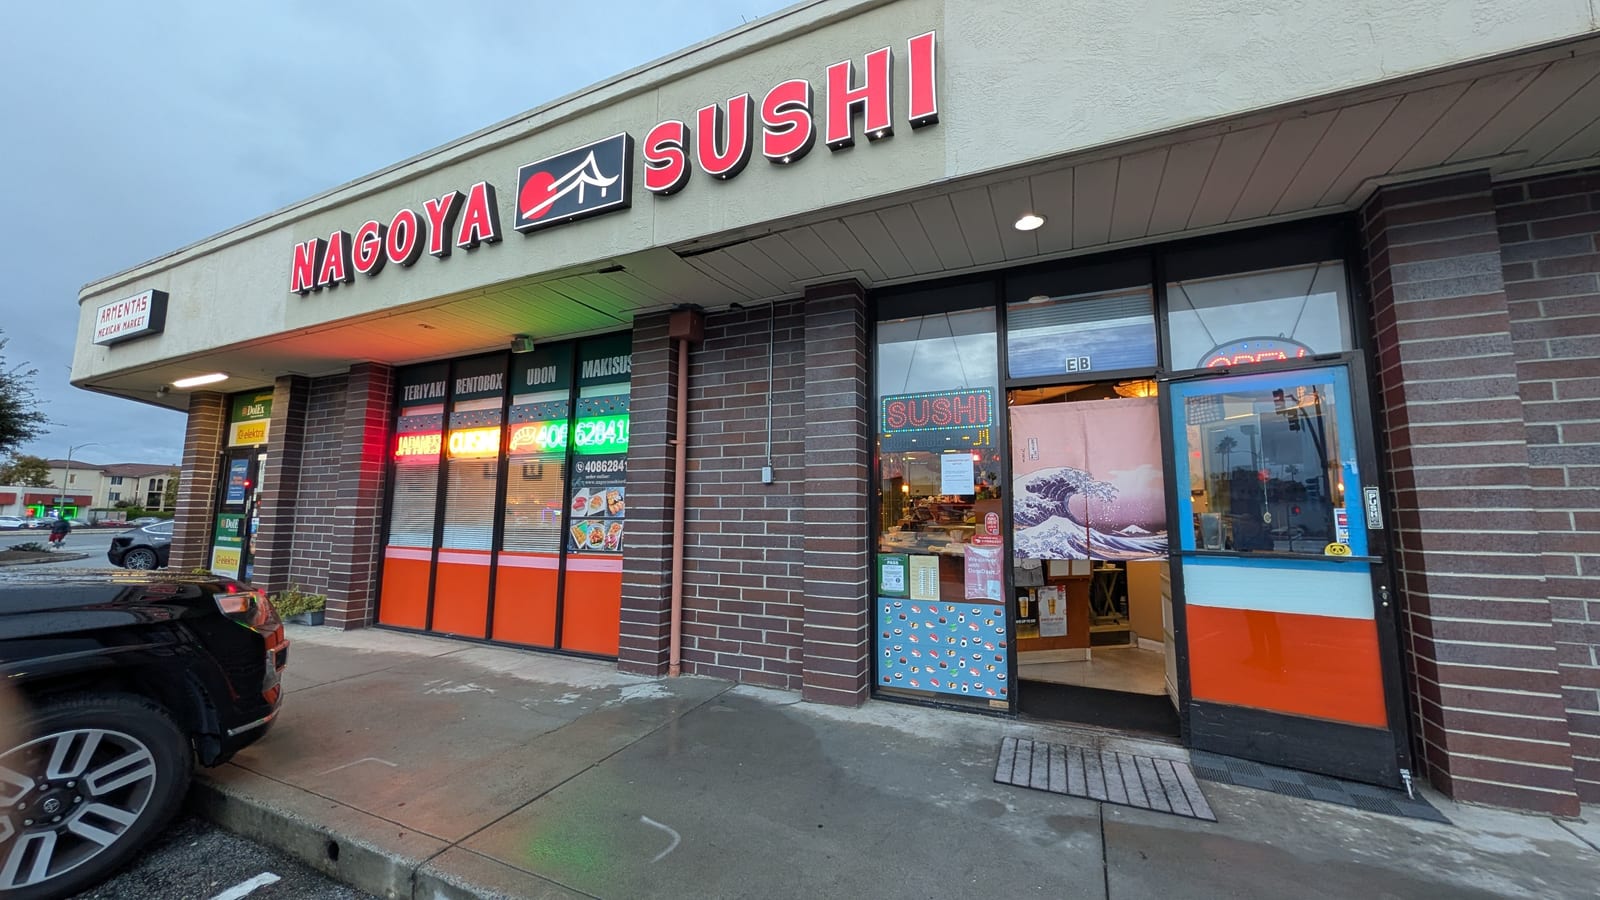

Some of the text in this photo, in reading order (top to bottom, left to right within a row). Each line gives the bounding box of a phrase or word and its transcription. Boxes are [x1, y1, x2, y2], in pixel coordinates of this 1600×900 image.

[291, 30, 938, 294] NAGOYA SUSHI
[101, 296, 147, 323] ARMENTAS
[98, 316, 145, 337] MEXICAN MARKET
[456, 373, 503, 395] BENTOBOX
[527, 365, 557, 386] UDON
[404, 381, 446, 401] TERIYAKI
[888, 395, 986, 428] SUSHI
[1368, 493, 1378, 518] PUSH
[226, 518, 239, 529] DolE
